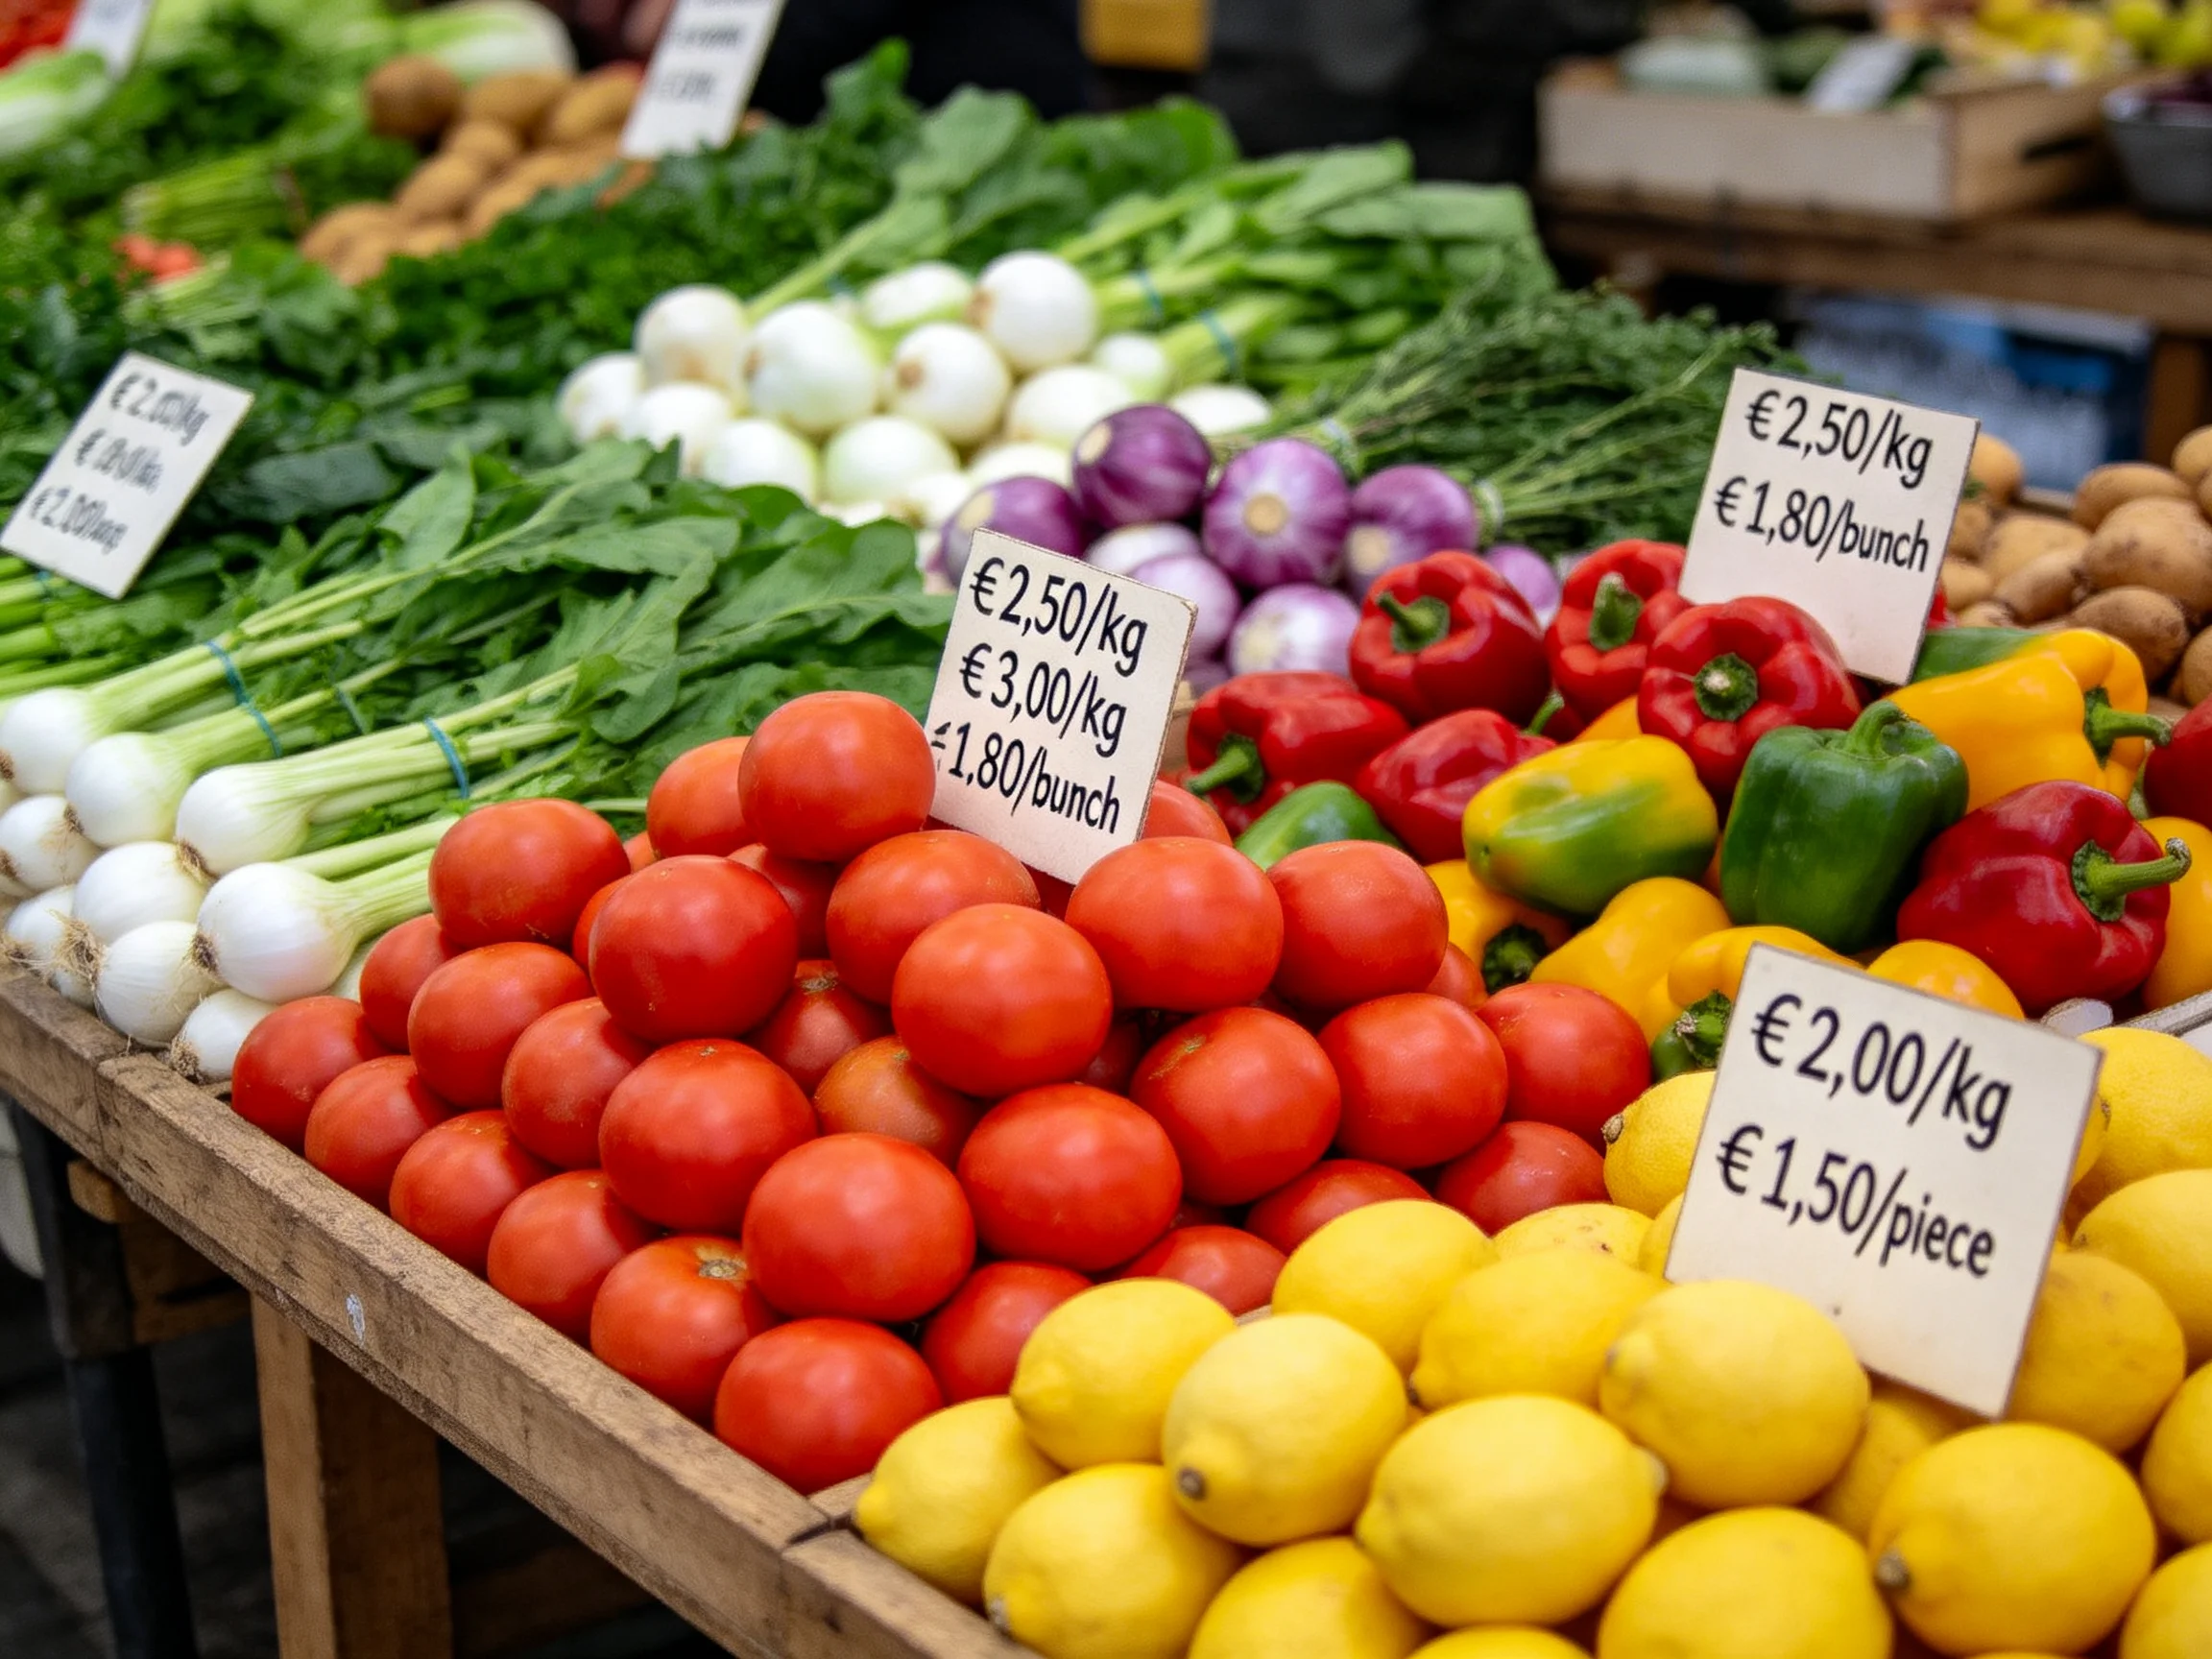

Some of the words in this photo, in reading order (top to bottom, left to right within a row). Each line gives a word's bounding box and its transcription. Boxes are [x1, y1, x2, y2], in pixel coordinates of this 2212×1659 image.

[1744, 389, 1934, 491] €2,50/kg
[1714, 475, 1930, 572] €1,80/bunch
[969, 557, 1148, 678] €2,50/kg
[959, 642, 1127, 758] €3,00/kg
[1751, 994, 2013, 1152] €2,00/kg
[1716, 1124, 1995, 1278] €1,50/piece
